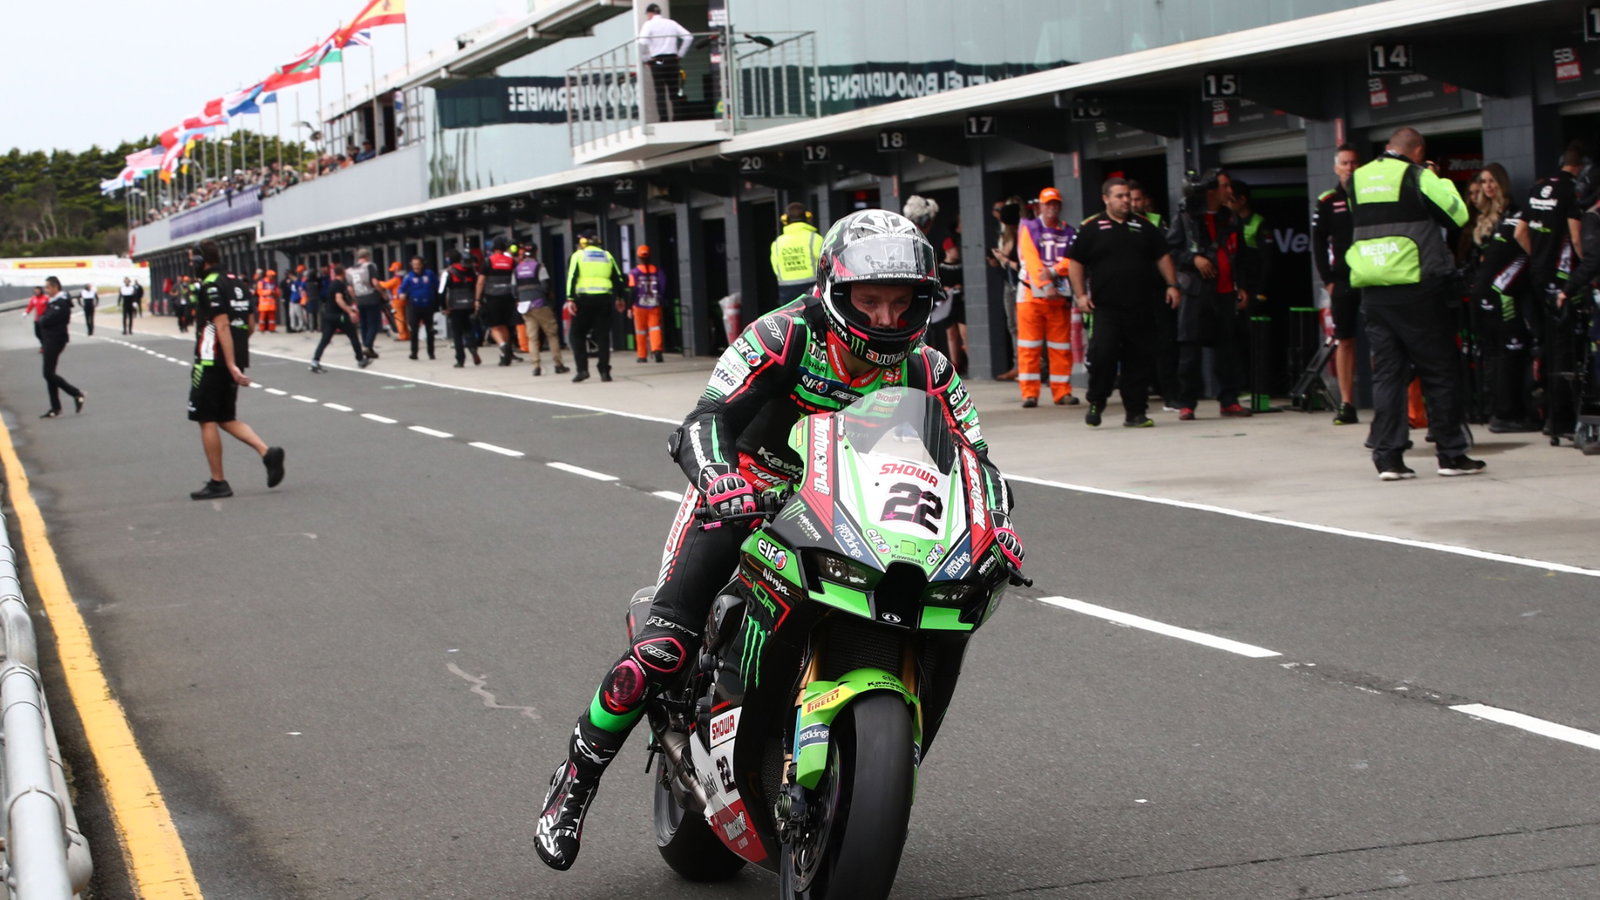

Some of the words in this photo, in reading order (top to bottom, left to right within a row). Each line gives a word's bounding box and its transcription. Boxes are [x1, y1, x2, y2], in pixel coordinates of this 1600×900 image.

[1373, 44, 1408, 68] 14
[1207, 74, 1237, 95] 15
[968, 117, 993, 134] 17
[880, 133, 904, 148] 18
[806, 145, 827, 160] 19
[740, 155, 762, 170] 20
[576, 187, 593, 198] 23
[615, 179, 633, 190] 22
[456, 208, 470, 218] 27
[482, 204, 497, 213] 26
[510, 200, 525, 209] 25
[1274, 228, 1310, 253] Ve
[1360, 243, 1399, 256] MEDIA
[802, 374, 817, 389] elf
[879, 463, 939, 488] SHOWA
[880, 482, 943, 535] 22
[866, 529, 886, 544] elf
[757, 538, 778, 562] elf
[926, 544, 941, 566] elf
[763, 567, 790, 596] Ninja
[640, 644, 679, 663] RST
[807, 689, 840, 713] PIRELLI
[712, 714, 735, 740] SHOWA
